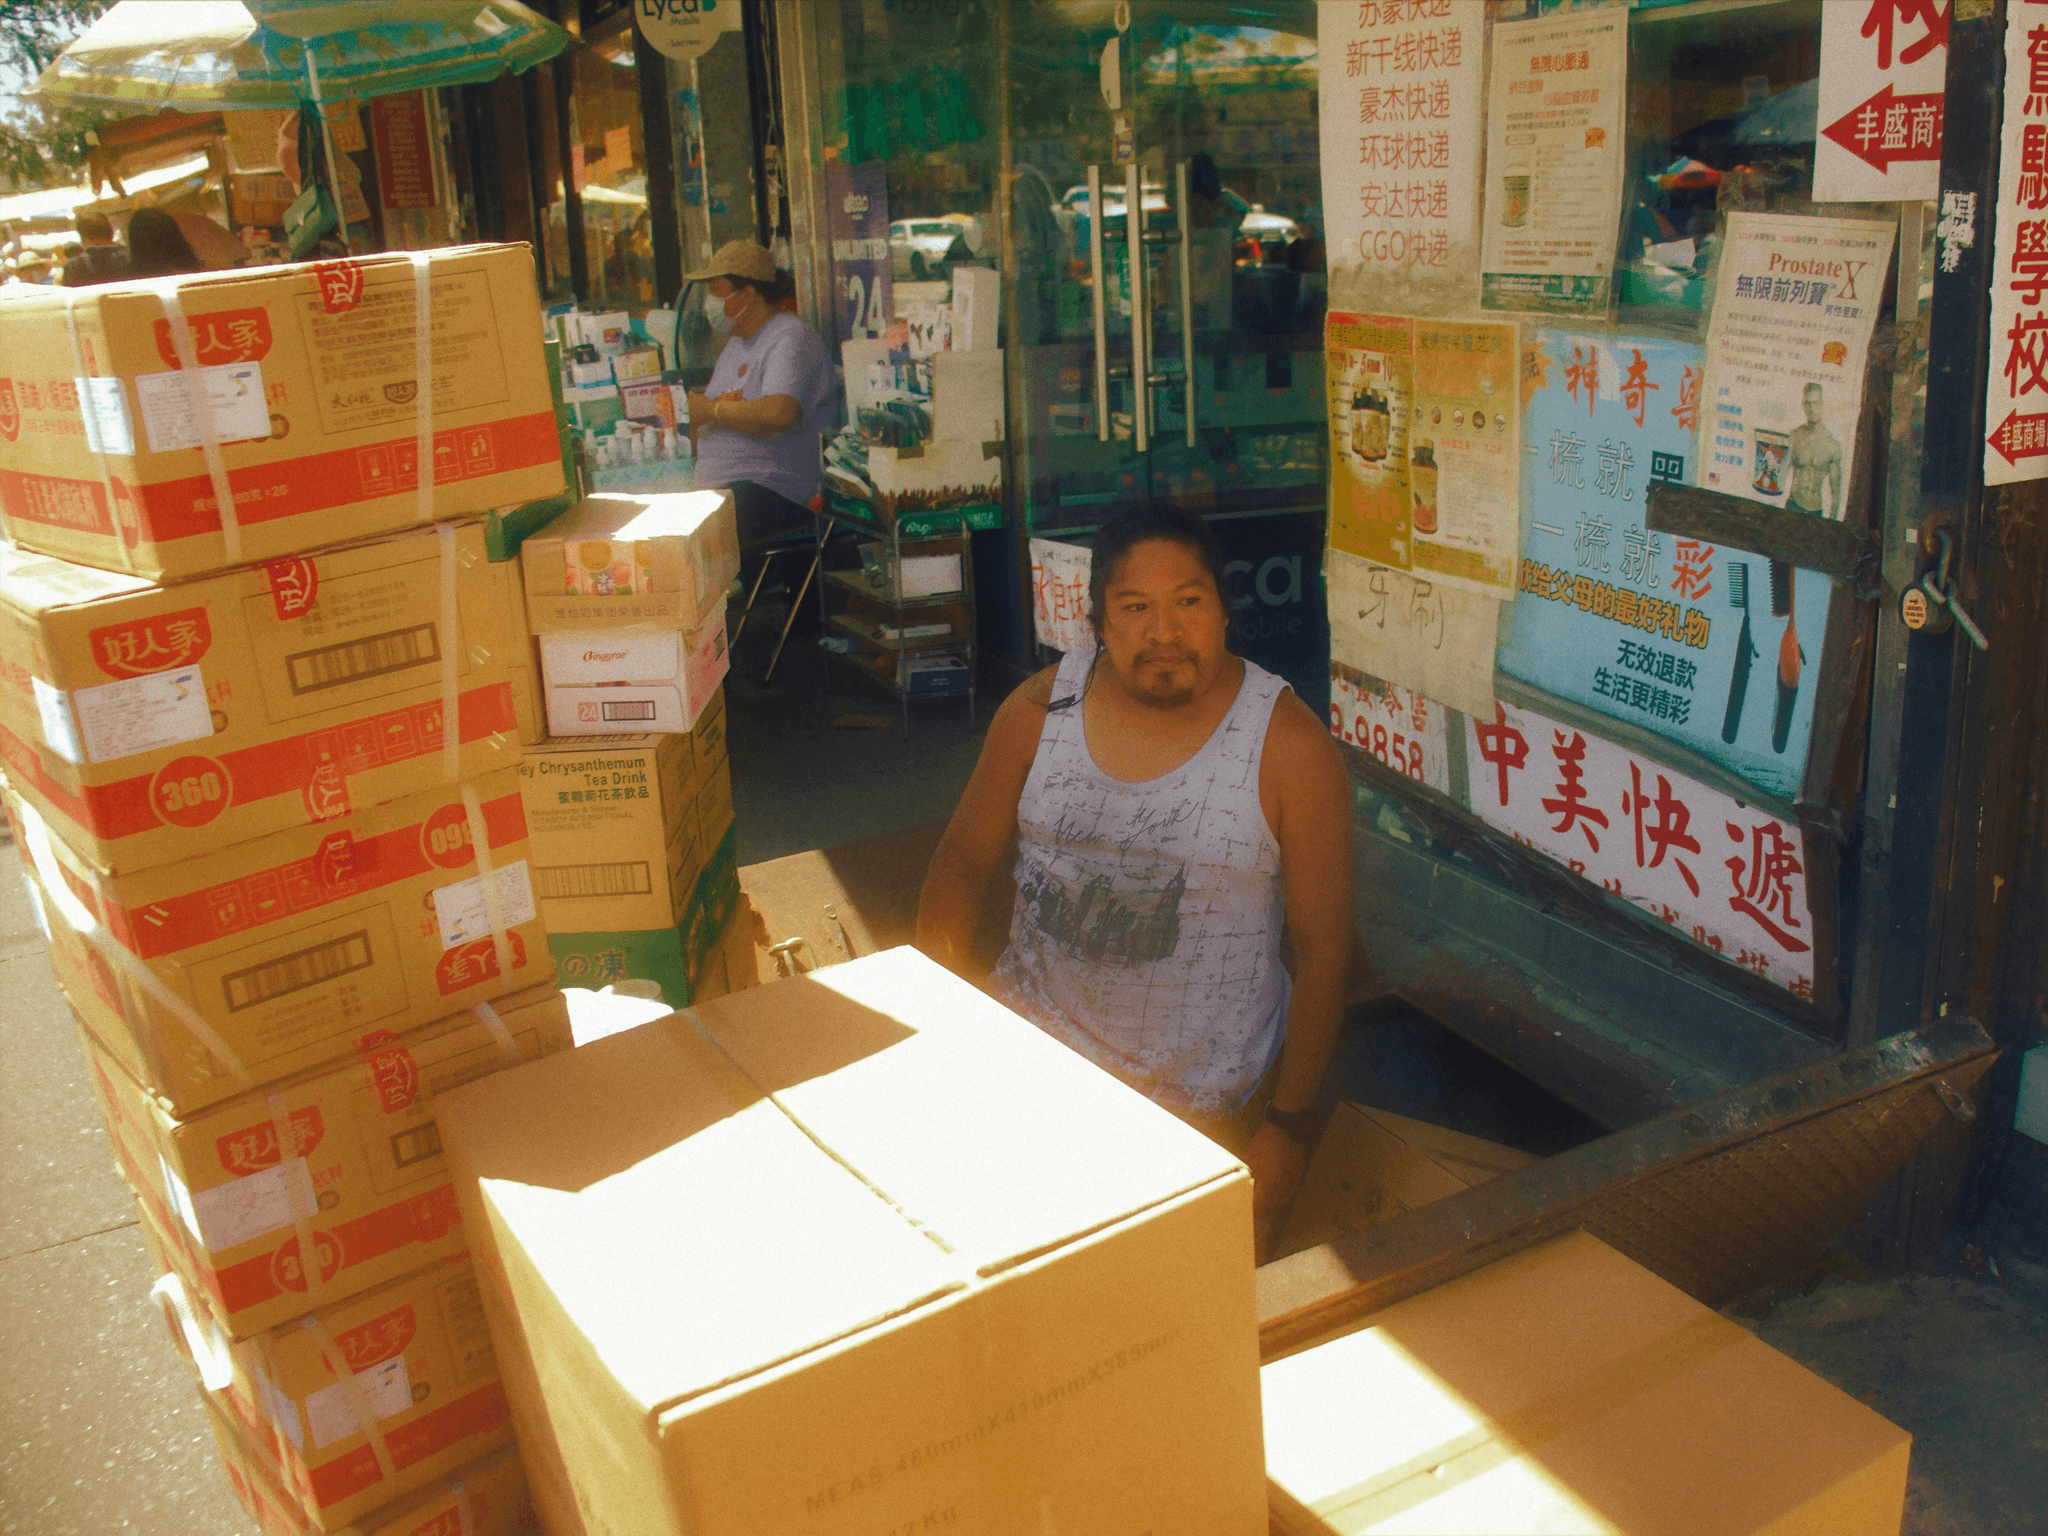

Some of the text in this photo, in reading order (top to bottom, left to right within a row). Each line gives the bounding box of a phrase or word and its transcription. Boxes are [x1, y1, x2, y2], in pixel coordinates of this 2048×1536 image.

[643, 0, 699, 20] Lyca
[1359, 79, 1451, 124] 豪杰快递
[1854, 102, 1943, 151] 丰盛商
[1359, 130, 1450, 171] 环球快递
[1360, 180, 1448, 219] 安达快递
[1359, 230, 1449, 268] CGO快递
[849, 275, 886, 340] 24
[1735, 273, 1829, 307] 無限前列寶
[167, 319, 264, 358] 人家
[1531, 511, 1716, 601] 一梳就彩
[103, 619, 202, 666] 好人家
[582, 650, 628, 663] Binggrae
[1615, 637, 1699, 692] 无效退款
[579, 703, 598, 722] 24
[1591, 666, 1693, 727] 生活更精彩
[539, 757, 647, 777] Chrysanthemum
[583, 770, 648, 787] Tea Drink
[162, 779, 220, 811] 360
[1473, 699, 1812, 953] 中美快遞
[281, 1243, 333, 1282] 30
